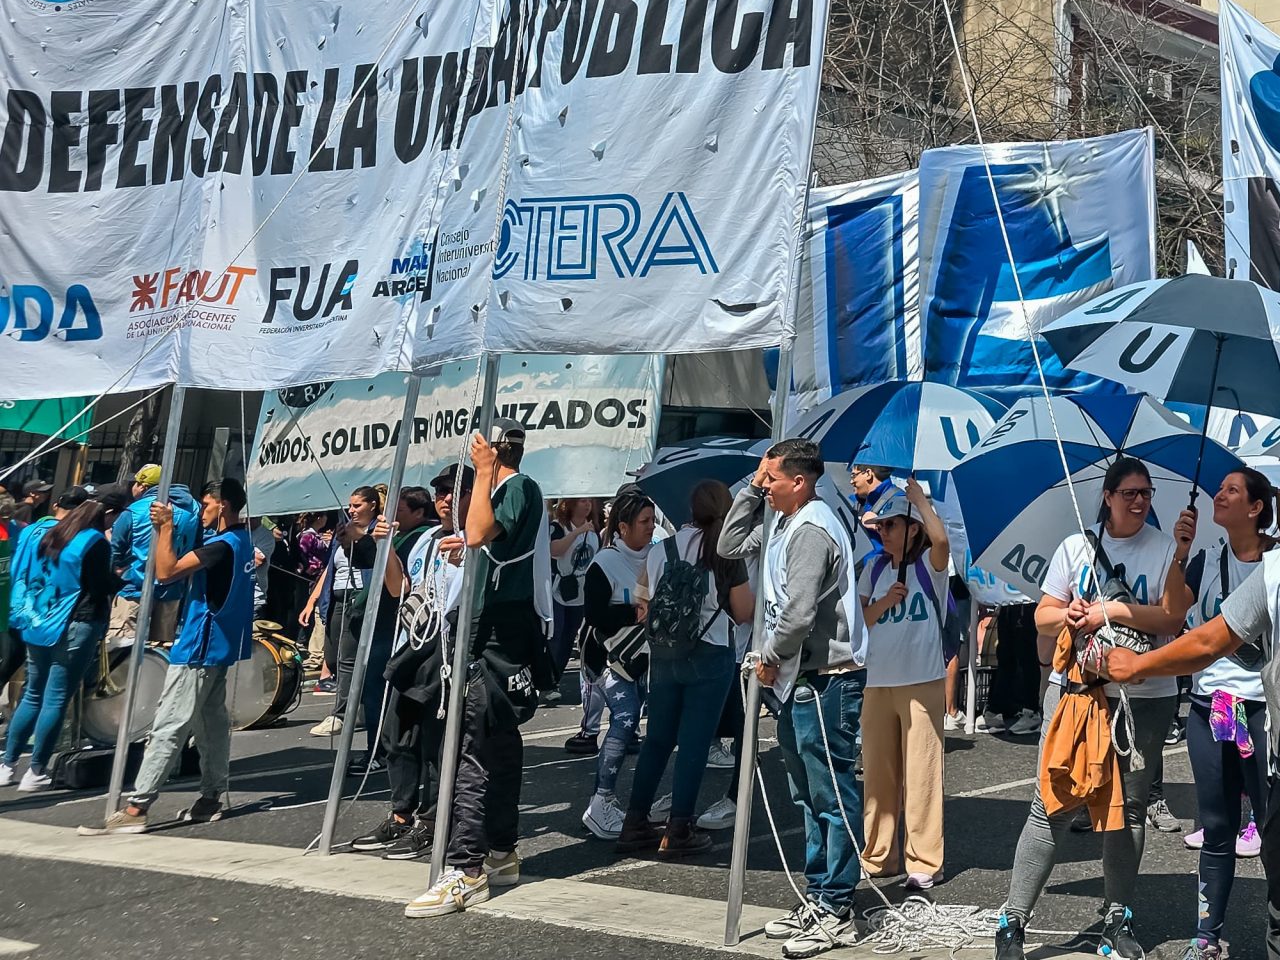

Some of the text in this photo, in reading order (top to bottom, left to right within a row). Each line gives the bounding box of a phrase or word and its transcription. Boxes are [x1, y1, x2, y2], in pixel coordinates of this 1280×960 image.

[0, 71, 248, 194] DEFENSA
[308, 63, 379, 172] LA
[436, 263, 472, 284] Nacional
[437, 240, 495, 264] Interuniversit
[261, 259, 359, 325] FUA
